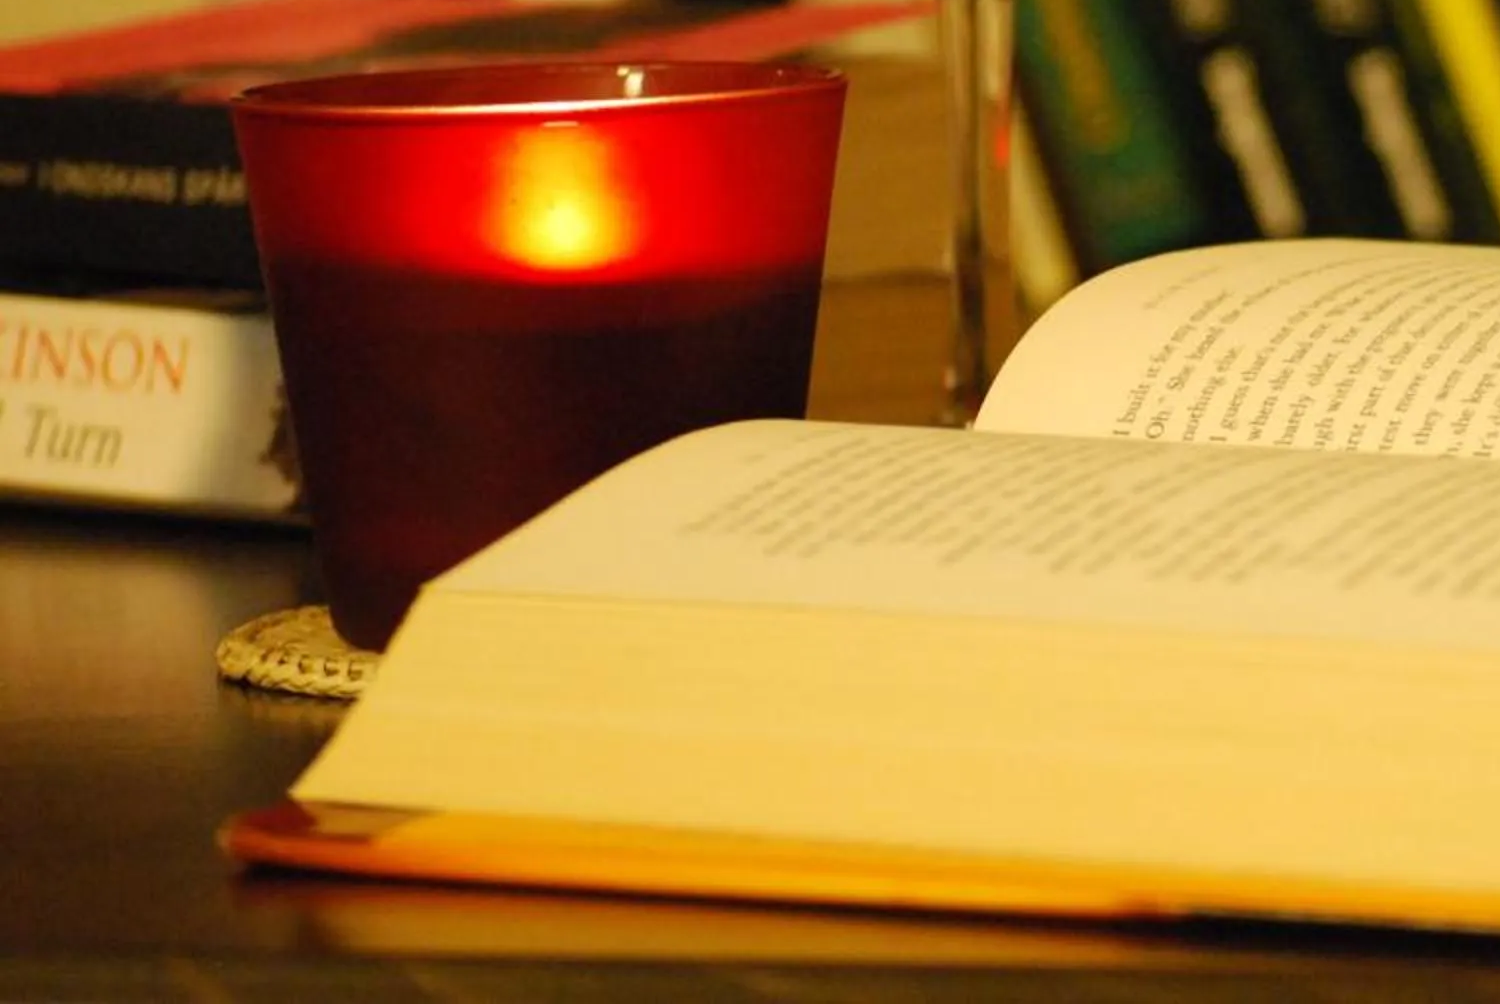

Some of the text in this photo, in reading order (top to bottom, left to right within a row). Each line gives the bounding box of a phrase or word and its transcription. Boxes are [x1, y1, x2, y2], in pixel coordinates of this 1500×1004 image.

[0, 318, 190, 396] INSON
[1165, 365, 1196, 391] She
[1116, 384, 1150, 423] built
[1182, 376, 1227, 441] nothing
[1220, 385, 1251, 431] guess
[1246, 395, 1279, 441] when
[1268, 366, 1295, 392] she
[1326, 377, 1357, 413] with
[1360, 385, 1386, 418] part
[24, 401, 123, 468] Turn
[1273, 393, 1315, 445] barely
[1412, 408, 1445, 446] they
[1451, 408, 1476, 436] she
